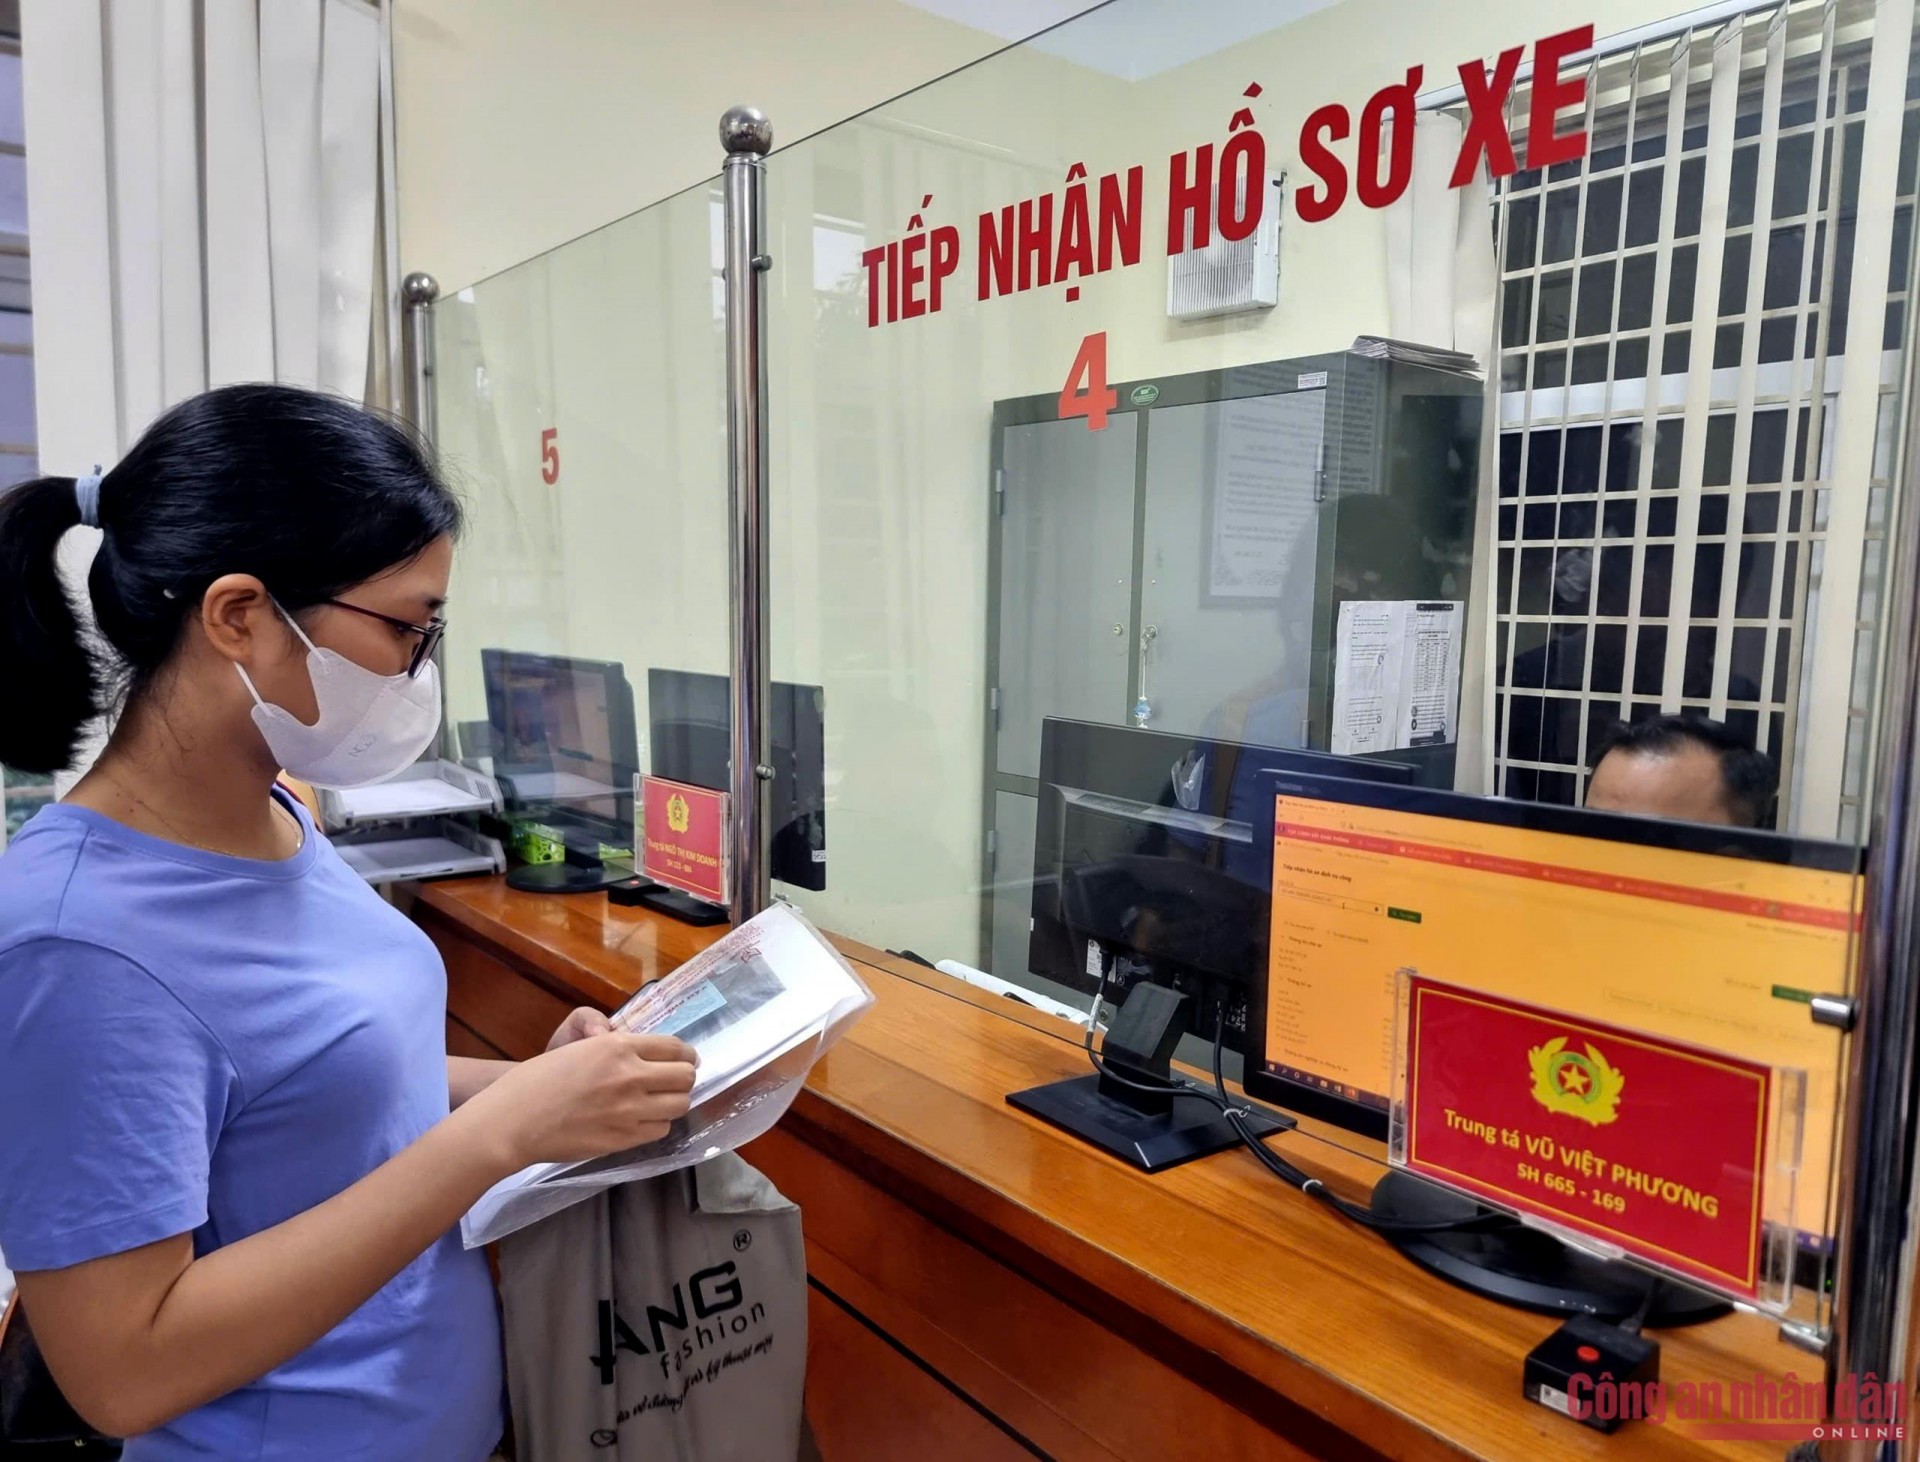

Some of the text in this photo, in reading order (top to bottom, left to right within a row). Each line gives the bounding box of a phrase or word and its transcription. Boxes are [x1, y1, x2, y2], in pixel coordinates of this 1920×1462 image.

[862, 23, 1595, 328] TIẾP NHẬN HỒ SƠ XE
[1058, 331, 1117, 432] 4
[541, 427, 560, 485] 5
[1444, 1109, 1719, 1219] Trung tá VŨ VIỆT PHƯƠNG
[1517, 1162, 1540, 1185] SH
[1543, 1170, 1576, 1197] 665
[1592, 1188, 1626, 1214] 169
